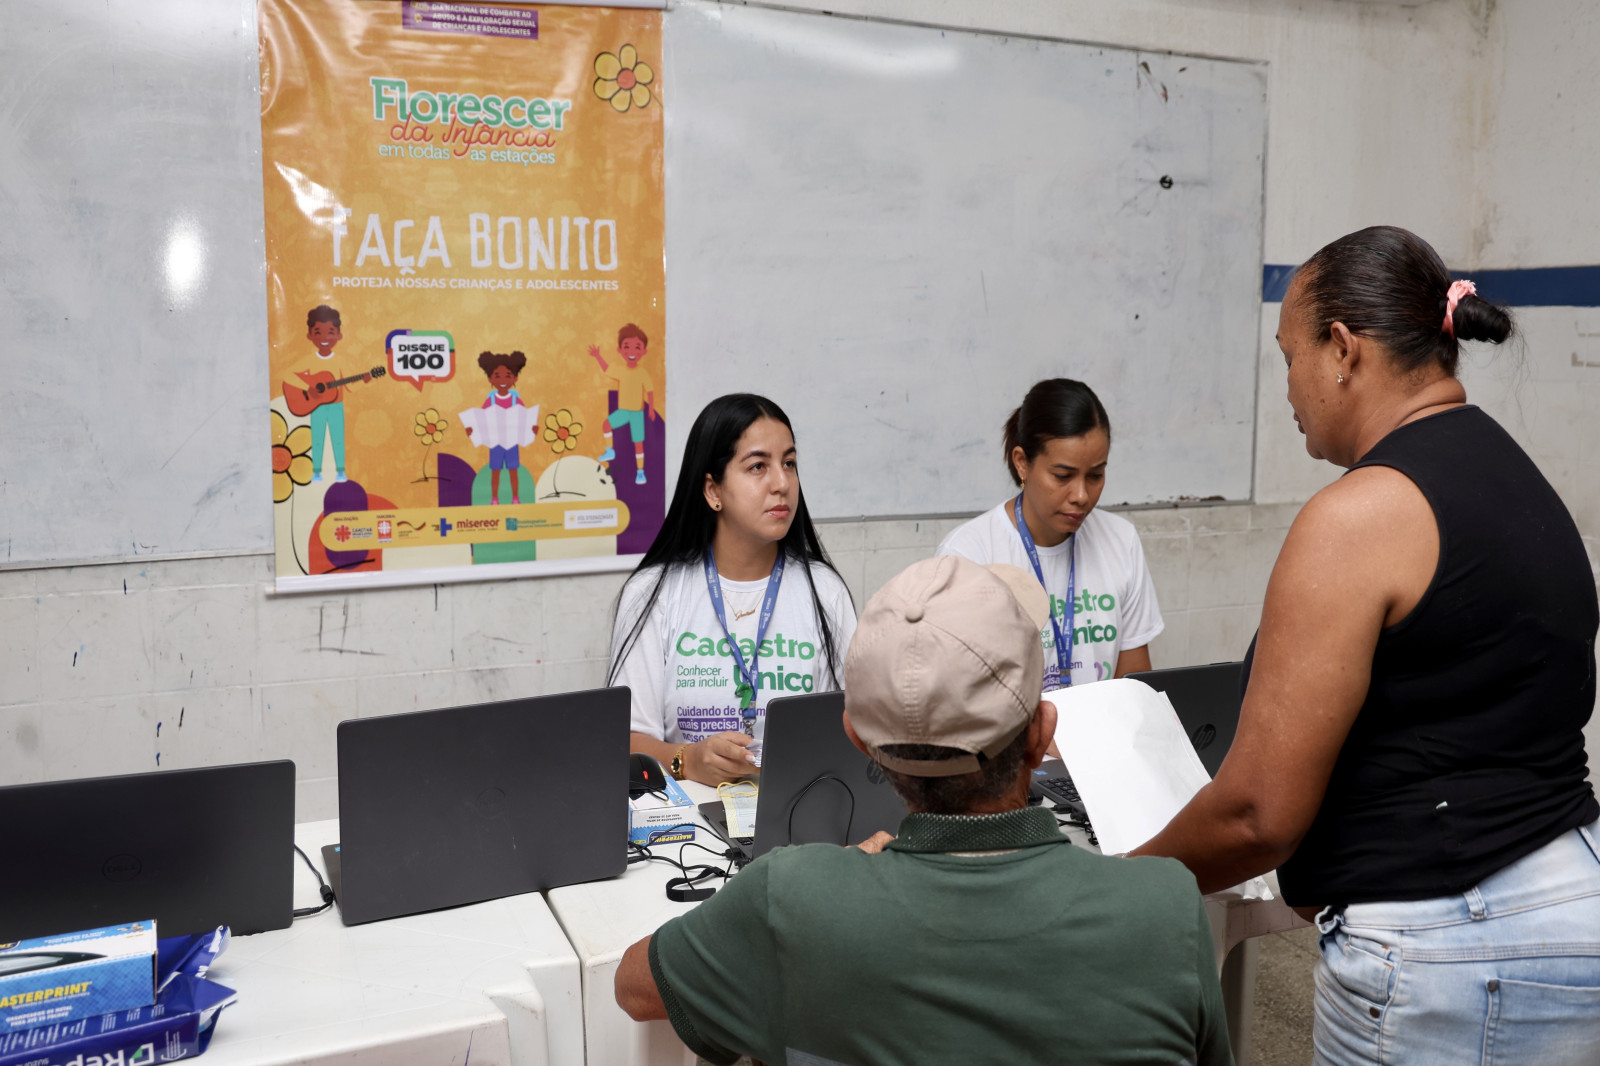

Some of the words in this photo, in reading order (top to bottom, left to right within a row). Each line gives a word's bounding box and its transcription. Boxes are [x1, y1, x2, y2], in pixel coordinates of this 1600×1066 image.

[445, 5, 478, 14] NACIONAL
[490, 8, 521, 17] COMBATE
[433, 12, 455, 20] ABUSO
[469, 15, 511, 26] EXPLORAÇÃO
[512, 19, 536, 28] SEXUAL
[443, 22, 476, 32] CRIANÇAS
[482, 25, 531, 36] ADOLESCENTES
[370, 77, 571, 129] Florescer
[390, 112, 434, 142] da
[442, 110, 556, 157] Infância
[378, 145, 405, 158] em
[408, 143, 450, 160] todas
[470, 150, 487, 161] as
[490, 148, 556, 166] estações
[332, 207, 452, 275] FAÇA
[469, 212, 618, 272] BONITO
[332, 276, 392, 289] PROTEJA
[397, 276, 446, 289] NOSSAS
[449, 278, 513, 291] CRIANÇAS
[515, 279, 523, 289] E
[525, 279, 619, 291] ADOLESCENTES
[398, 343, 445, 353] DISQUE
[397, 354, 444, 370] 100
[456, 518, 500, 528] misereor
[1050, 588, 1115, 618] astro
[1060, 618, 1117, 645] nico
[676, 632, 815, 660] Cadastro
[677, 664, 722, 676] Conhecer
[676, 677, 696, 690] para
[699, 676, 728, 687] incluir
[677, 705, 721, 717] Cuidando
[723, 705, 736, 716] de
[679, 719, 699, 730] mais
[701, 718, 737, 732] precisa
[0, 981, 90, 1008] ASTERPRINT
[52, 1049, 126, 1066] Rep
